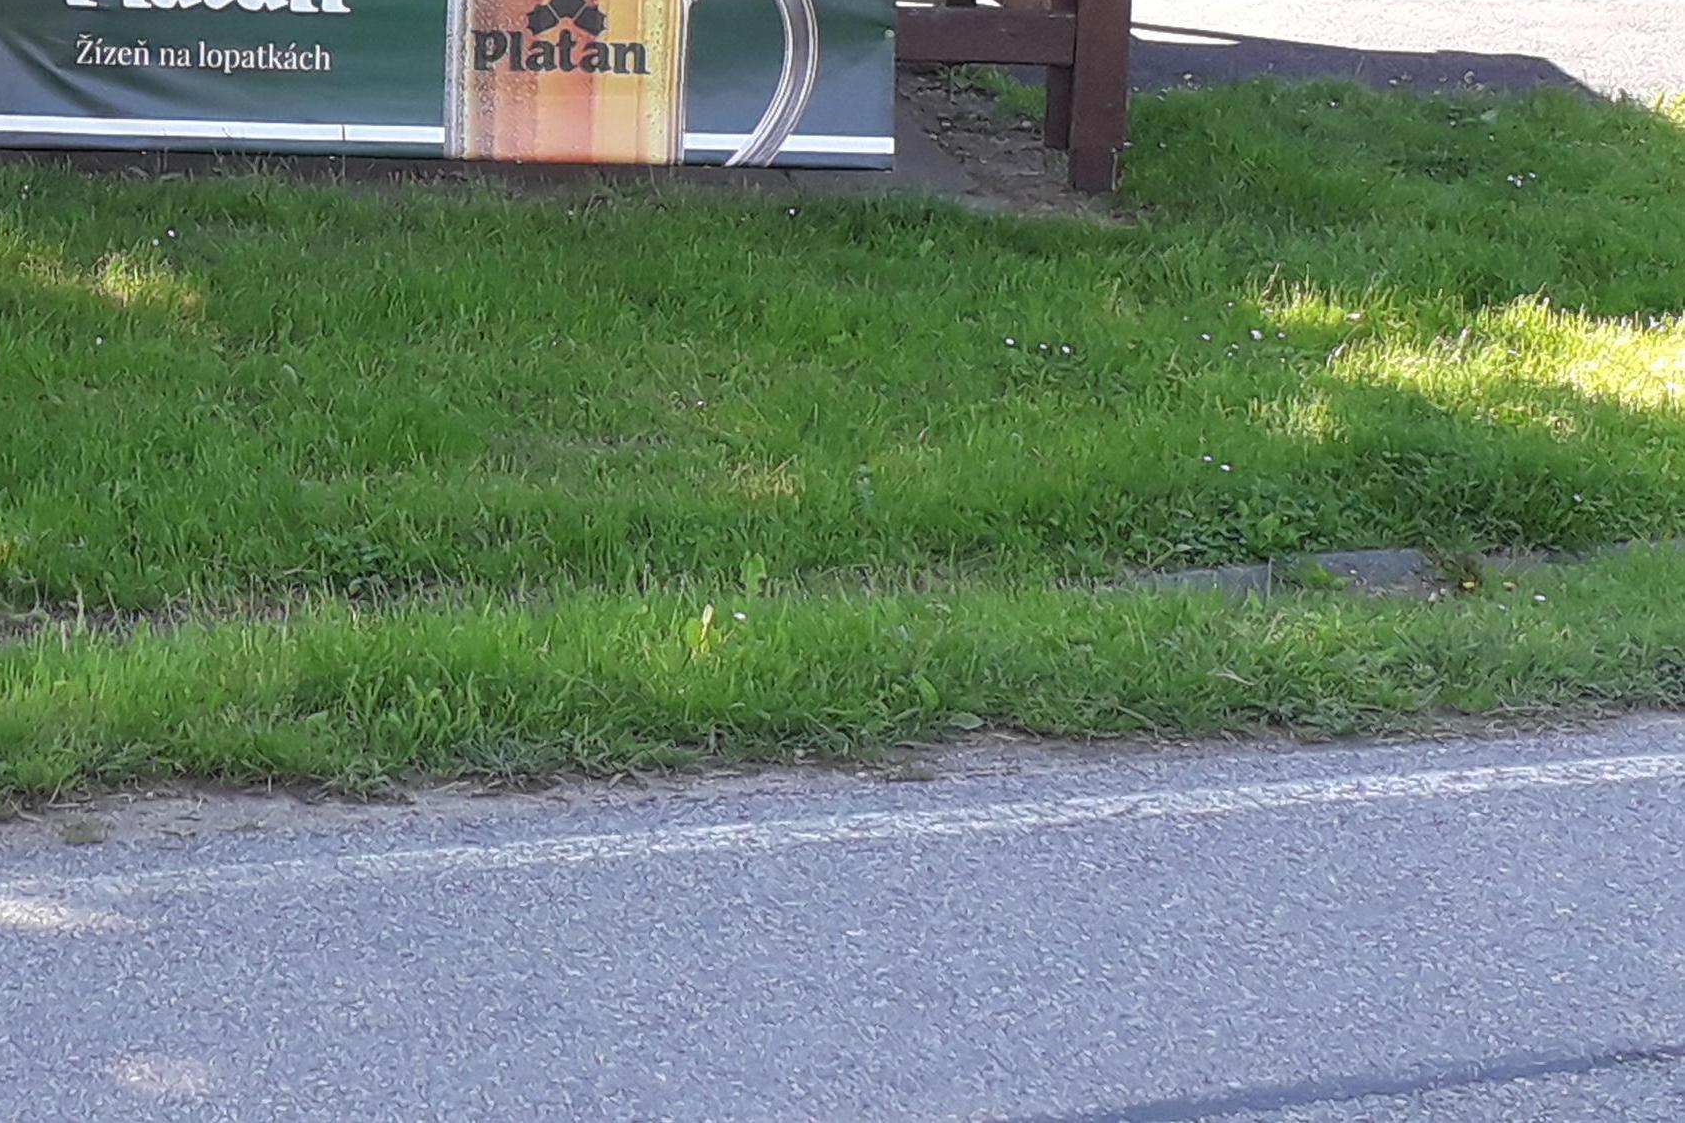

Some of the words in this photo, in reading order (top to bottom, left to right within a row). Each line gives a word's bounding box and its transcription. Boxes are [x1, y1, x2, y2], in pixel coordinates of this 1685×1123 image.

[75, 33, 150, 66] Žízeň
[158, 46, 192, 68] na
[198, 40, 332, 74] lopatkách
